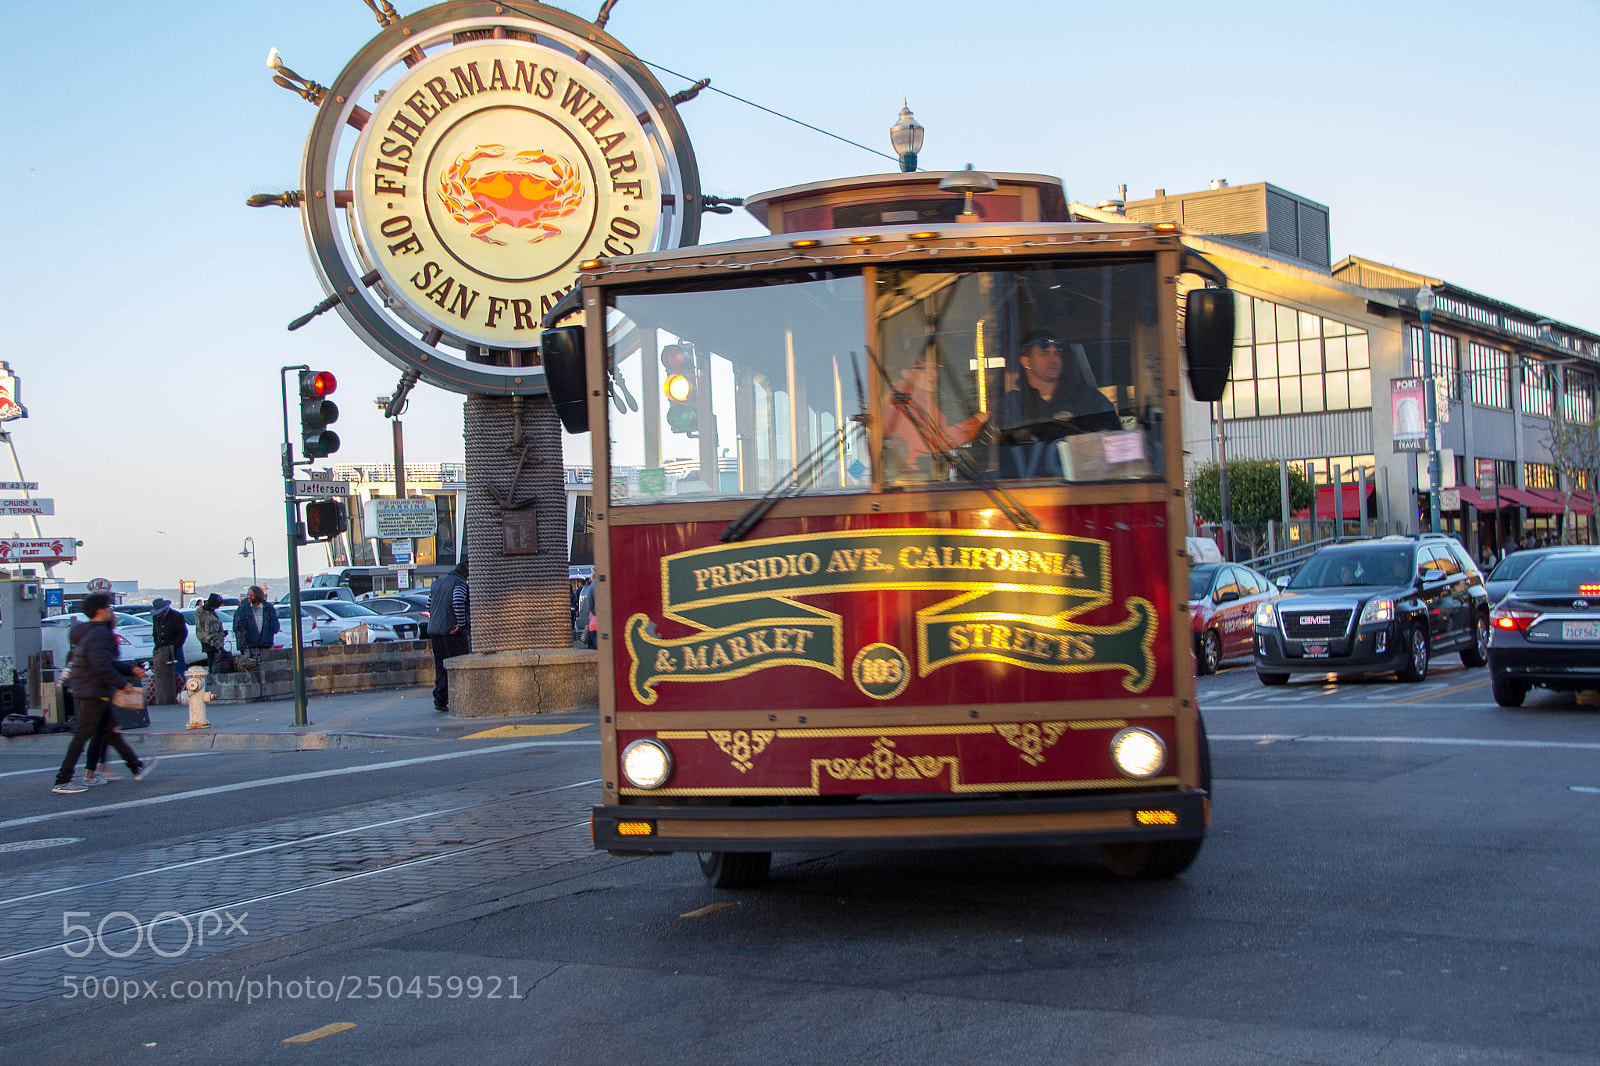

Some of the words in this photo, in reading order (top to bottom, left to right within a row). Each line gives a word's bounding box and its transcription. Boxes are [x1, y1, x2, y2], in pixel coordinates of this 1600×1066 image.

[374, 58, 559, 197] FISHERMANS
[560, 77, 644, 200] WHARF
[380, 214, 425, 258] OF
[409, 261, 480, 320] SAN
[1396, 379, 1417, 390] PORT
[1398, 441, 1421, 449] TRAVEL
[10, 482, 20, 490] 43
[23, 482, 36, 490] 1/2
[300, 483, 346, 494] Jefferson
[692, 552, 821, 592] PRESIDIO
[898, 546, 1087, 579] CALIFORNIA
[1299, 615, 1331, 625] GMC
[654, 648, 678, 674] &
[681, 627, 815, 671] MARKET
[948, 623, 1096, 662] STREETS
[861, 657, 904, 684] 103
